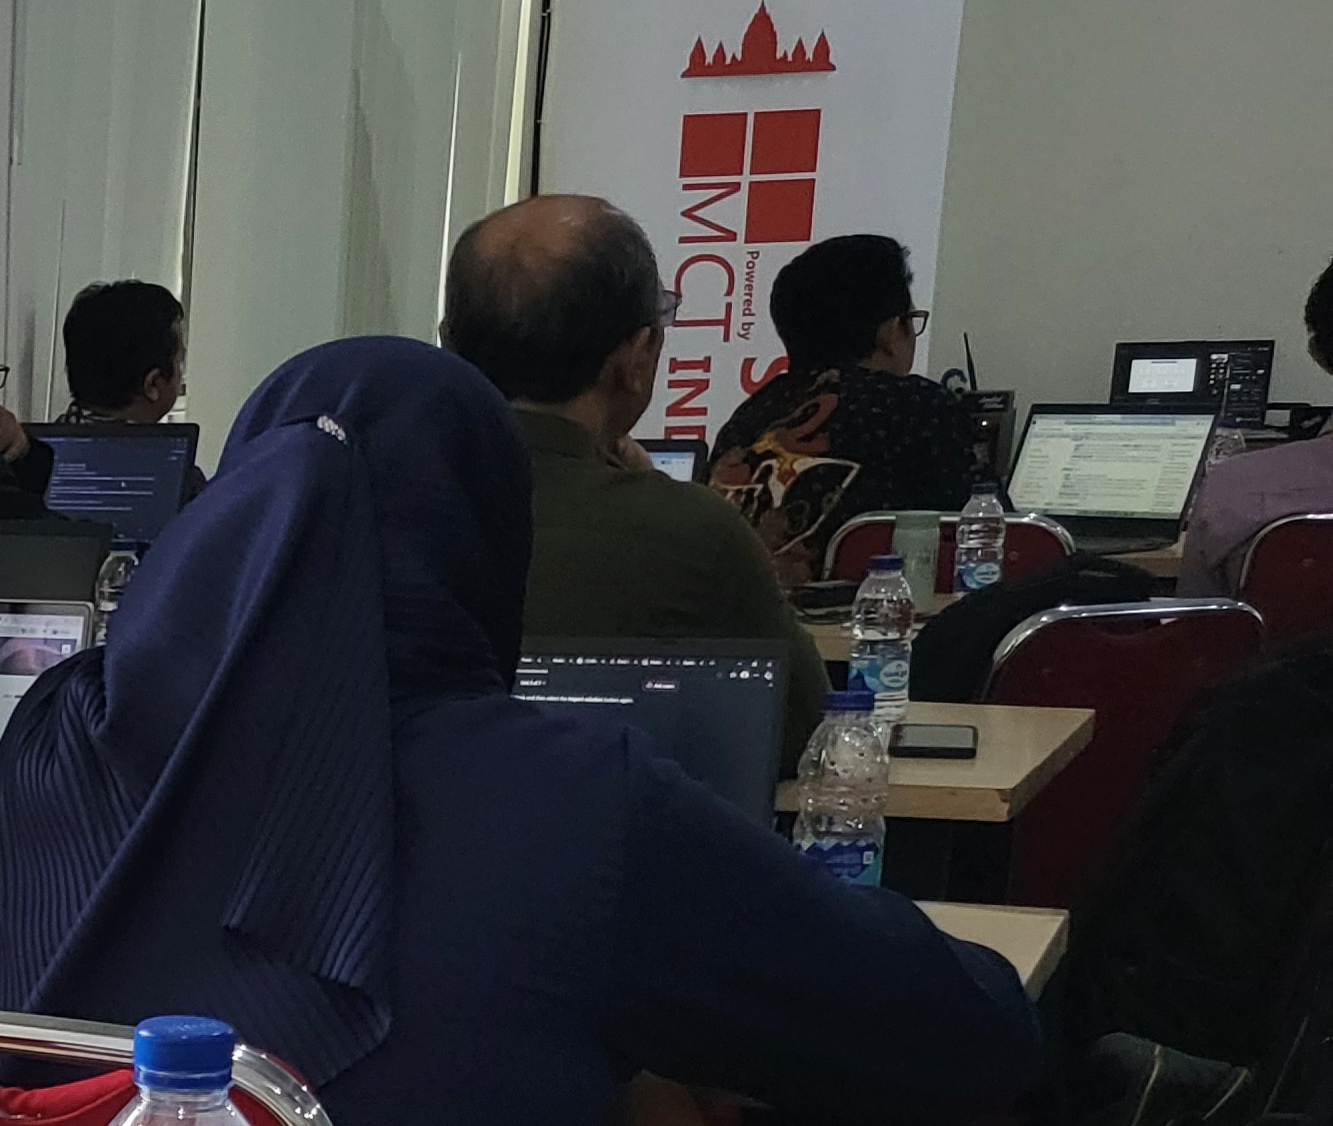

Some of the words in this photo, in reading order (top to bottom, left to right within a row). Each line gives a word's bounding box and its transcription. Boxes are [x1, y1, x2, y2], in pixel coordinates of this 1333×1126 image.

[673, 181, 741, 342] MCT
[742, 251, 760, 317] Powered
[737, 321, 755, 341] by
